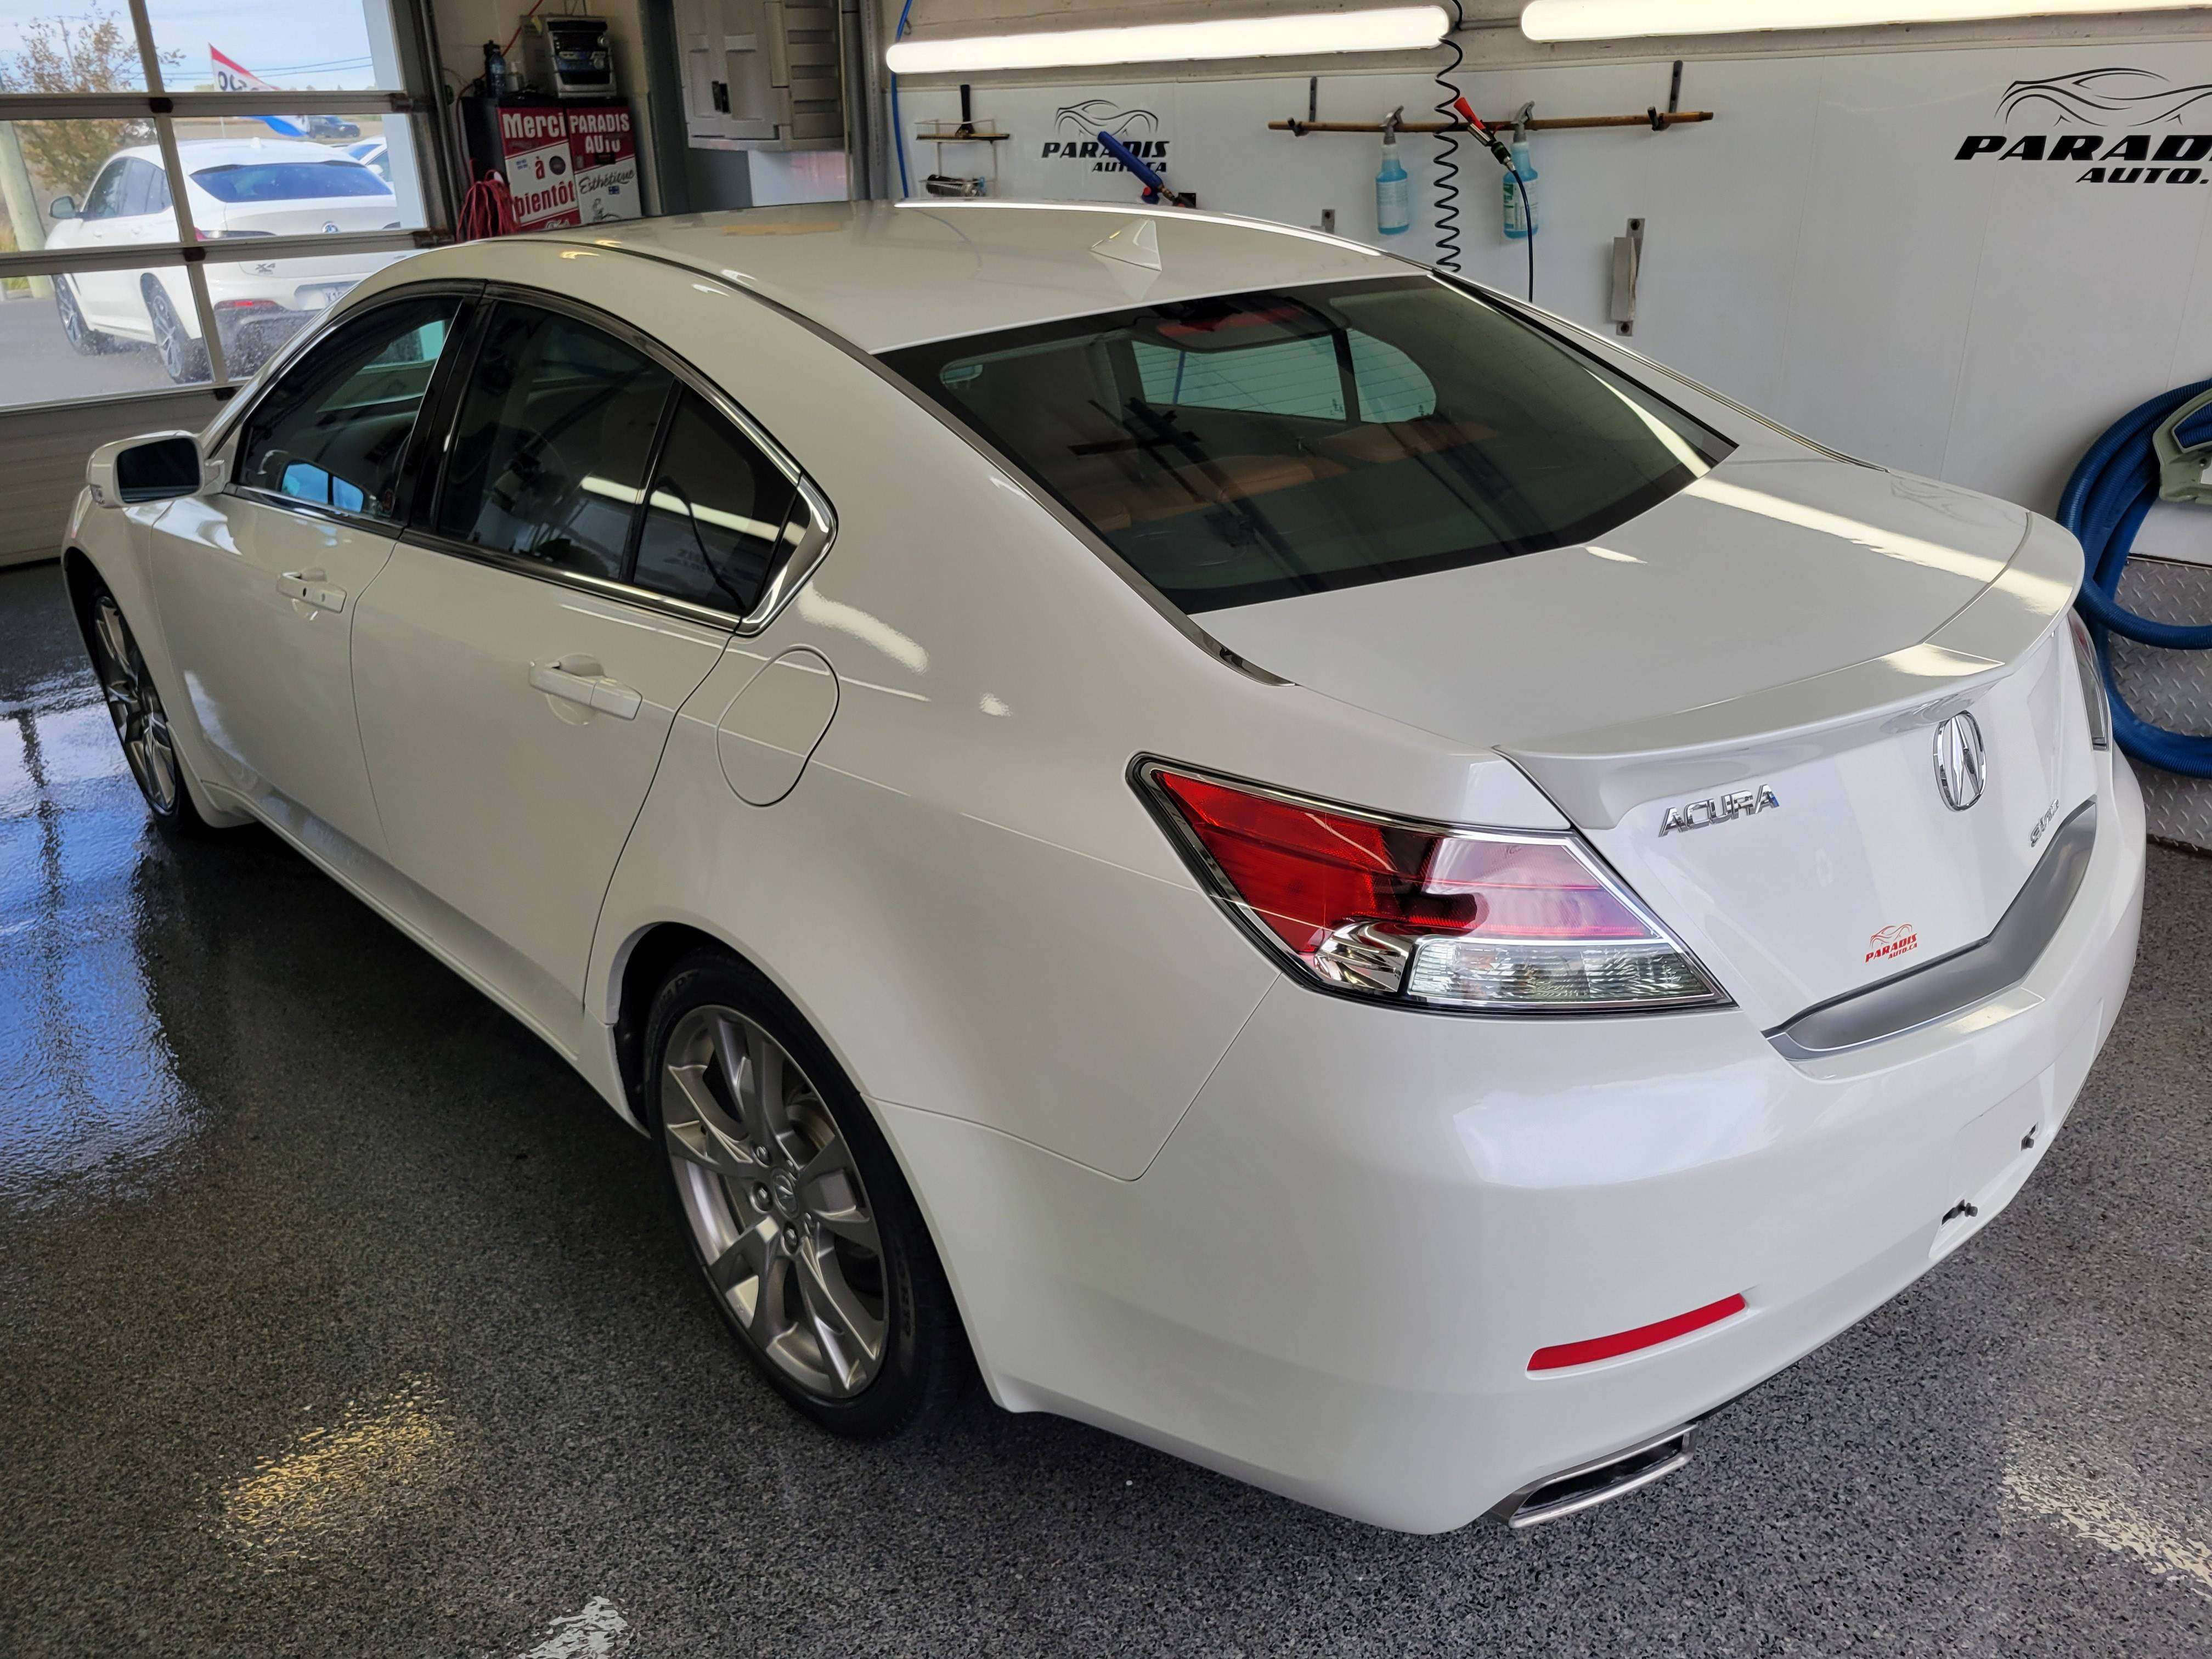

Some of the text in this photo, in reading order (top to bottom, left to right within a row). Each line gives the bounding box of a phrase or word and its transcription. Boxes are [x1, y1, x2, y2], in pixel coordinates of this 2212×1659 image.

[503, 112, 567, 139] Merci
[569, 113, 630, 134] PARADIS
[1954, 135, 2212, 161] PARAD
[534, 156, 545, 180] à
[579, 170, 635, 194] Esthétique
[514, 180, 575, 217] bientôt
[1658, 784, 1780, 838] ACURA
[1865, 933, 1917, 963] PARADIS
[1888, 943, 1917, 960] AUTO.CA
